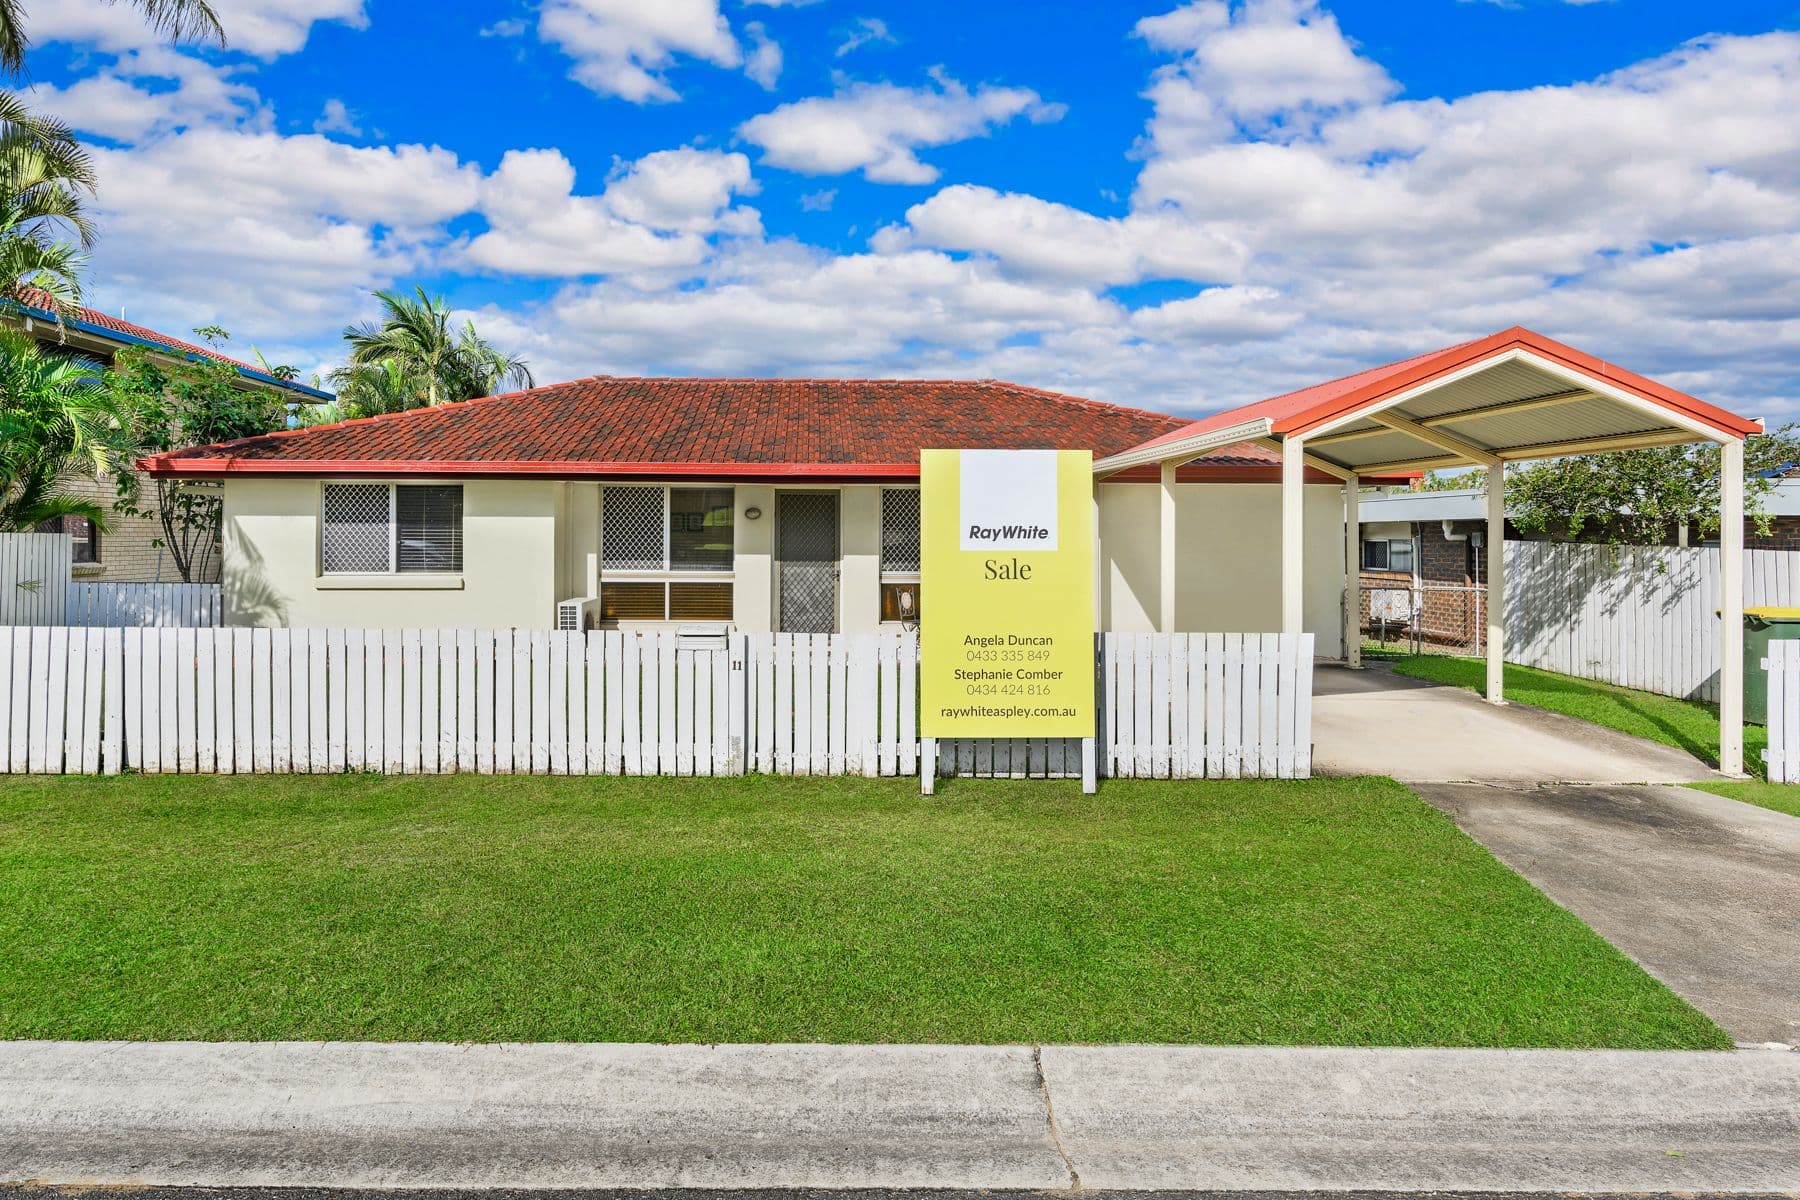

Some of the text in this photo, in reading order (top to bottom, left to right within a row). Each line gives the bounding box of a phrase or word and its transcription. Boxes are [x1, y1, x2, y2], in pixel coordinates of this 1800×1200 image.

[984, 558, 1032, 580] Sale
[964, 635, 1053, 648] Angela Duncan
[966, 650, 1050, 661] 0433 335 849
[732, 660, 742, 670] 11
[954, 668, 1063, 682] Stephanie Comber
[966, 684, 1050, 695] 0434 424 816
[941, 705, 1076, 719] raywhiteaspley.com.au
